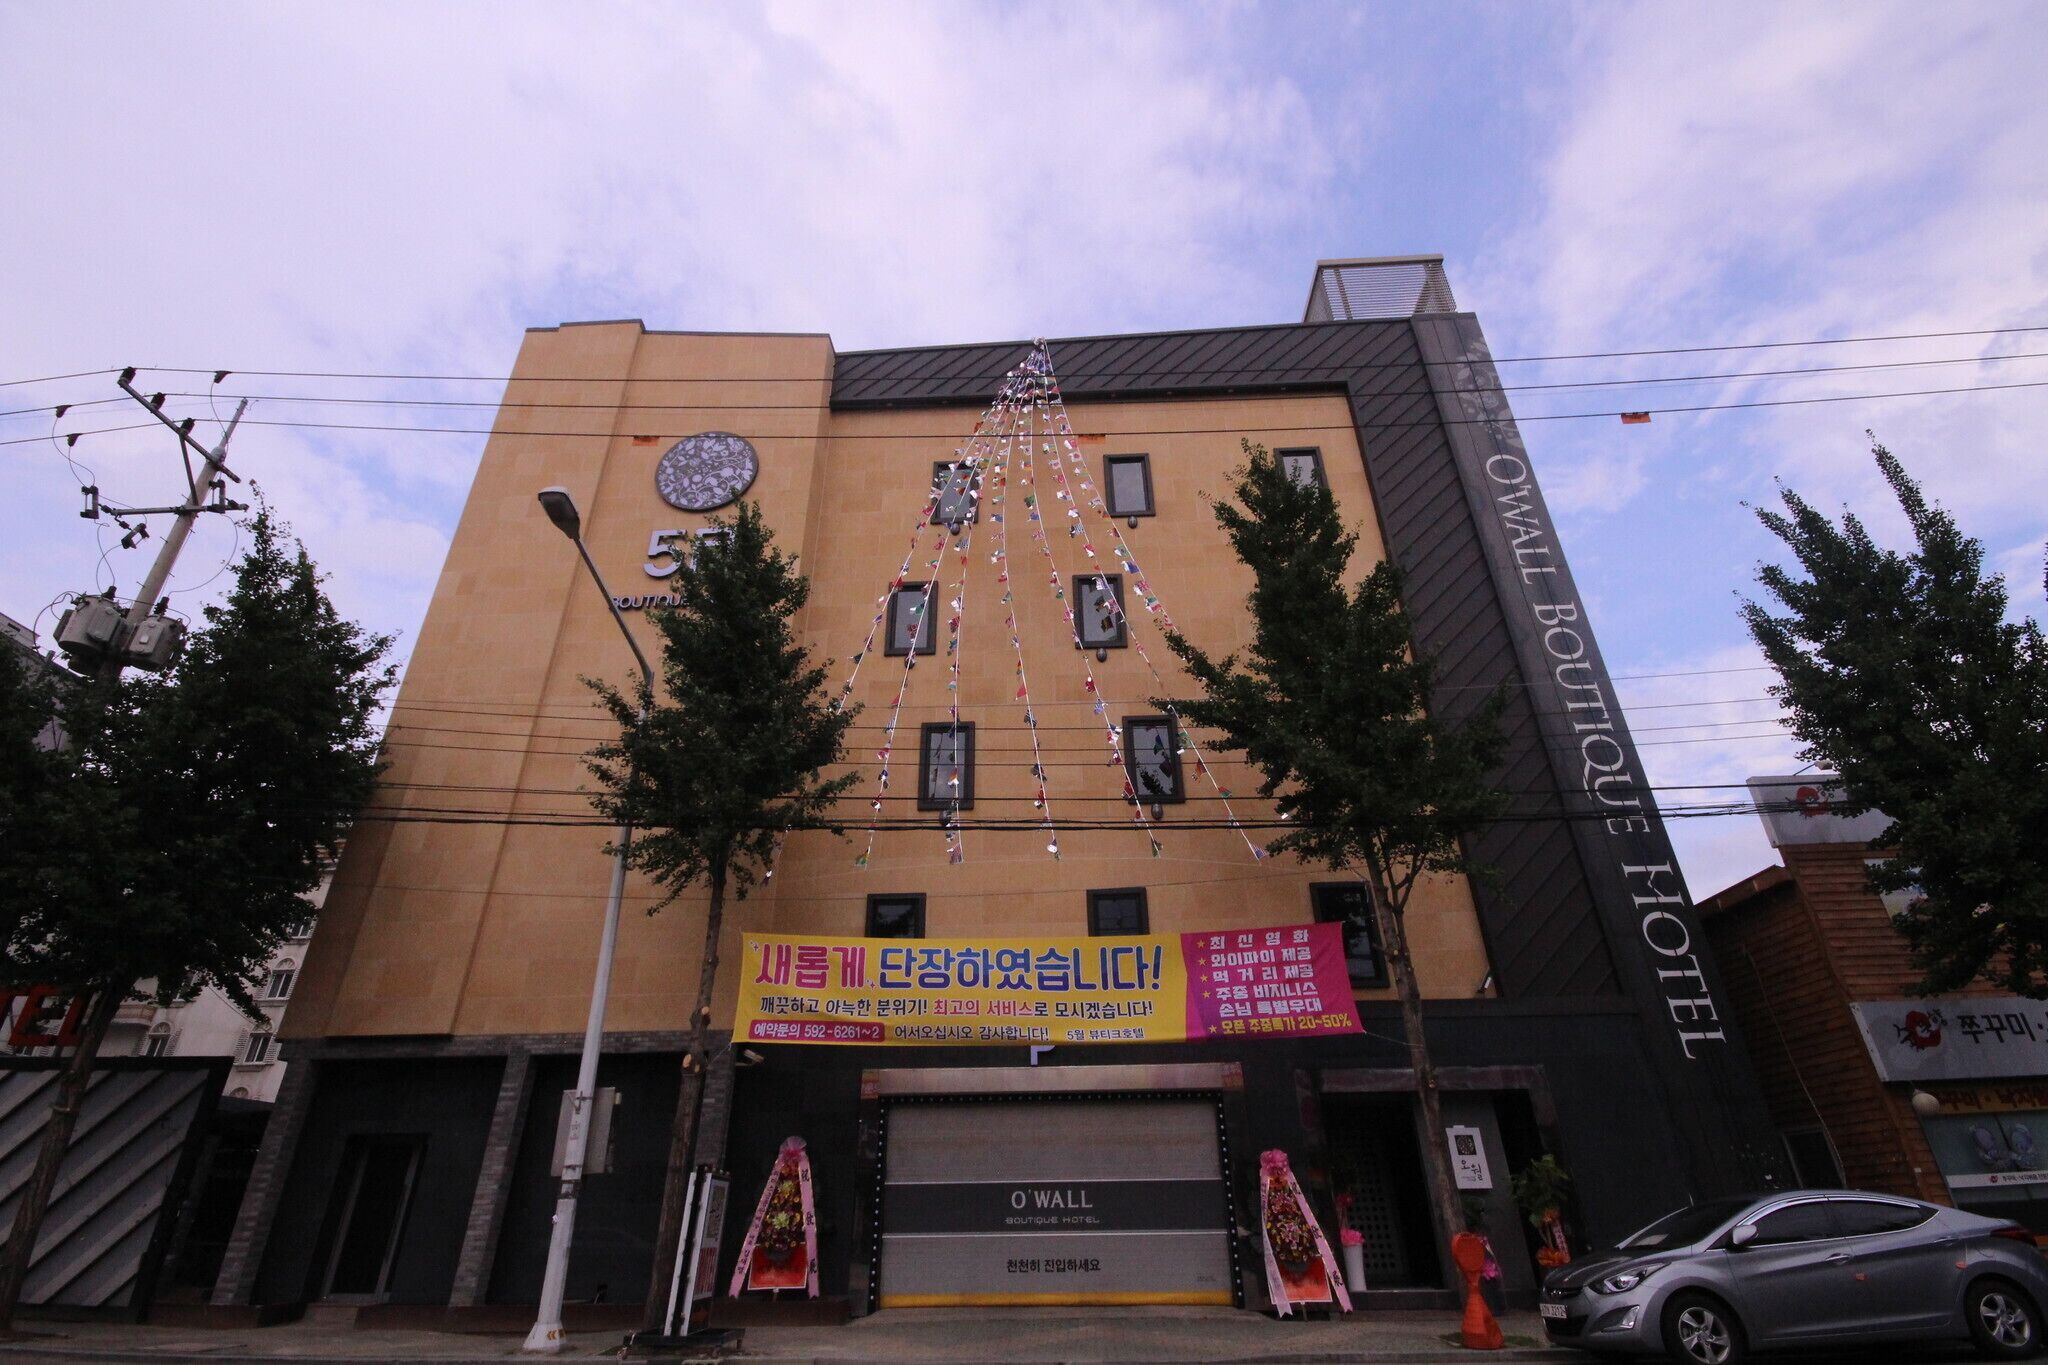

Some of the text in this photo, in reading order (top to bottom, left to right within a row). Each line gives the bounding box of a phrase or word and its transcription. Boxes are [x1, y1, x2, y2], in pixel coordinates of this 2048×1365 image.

[1485, 454, 1558, 585] O'WALL
[1533, 600, 1651, 835] BOUTIQUE
[1210, 946, 1312, 967] 와이파이 제공
[755, 943, 1162, 991] 새롭게 단장하였습니다!
[1283, 963, 1314, 979] 제공
[1215, 982, 1319, 1001] 주중 비지니스
[760, 996, 1153, 1019] 깨끗하고 아늑한 분위기! 최고의 서비스로 모시겠습니다!
[1219, 998, 1323, 1018] 손님 특별우대
[754, 1022, 880, 1038] 예약문의 592-6261~2
[894, 1025, 1049, 1041] 어서오십시오 감사합니다!
[1011, 1189, 1093, 1208] O'WALL
[1005, 1216, 1100, 1224] BOUTIQUE HOTEL
[1006, 1258, 1101, 1273] 천천히 진입하세요
